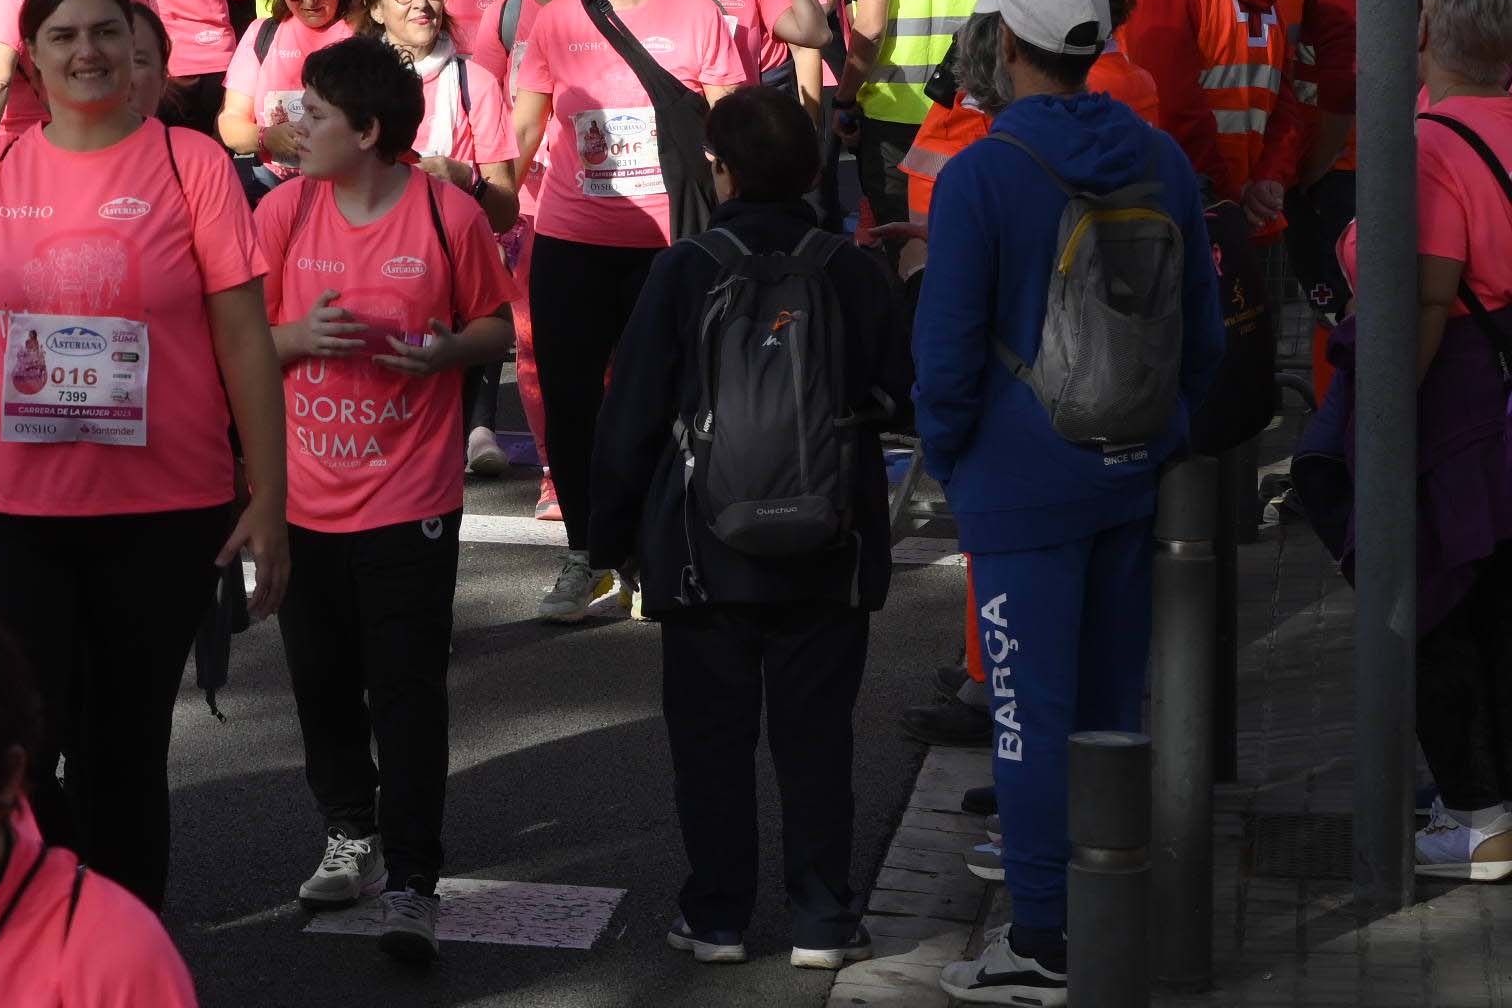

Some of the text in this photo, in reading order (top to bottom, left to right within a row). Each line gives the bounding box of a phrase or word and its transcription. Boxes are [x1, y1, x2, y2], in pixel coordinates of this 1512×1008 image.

[568, 41, 609, 53] OYSHO
[610, 141, 642, 156] 016
[297, 256, 345, 273] OYSHO
[51, 336, 102, 351] ASTURIANA
[51, 366, 98, 386] 016
[58, 390, 88, 403] 7399
[18, 406, 55, 415] CARRERA
[57, 408, 69, 416] DE
[70, 408, 81, 416] LA
[81, 408, 110, 417] MUJER
[294, 391, 413, 425] DORSAL
[14, 423, 135, 436] OYSHO Santander
[296, 425, 384, 458] SUMA
[369, 459, 387, 467] 2023
[1103, 449, 1148, 466] SINCE 1899
[756, 506, 798, 515] Quechua
[980, 591, 1024, 762] BARÇA
